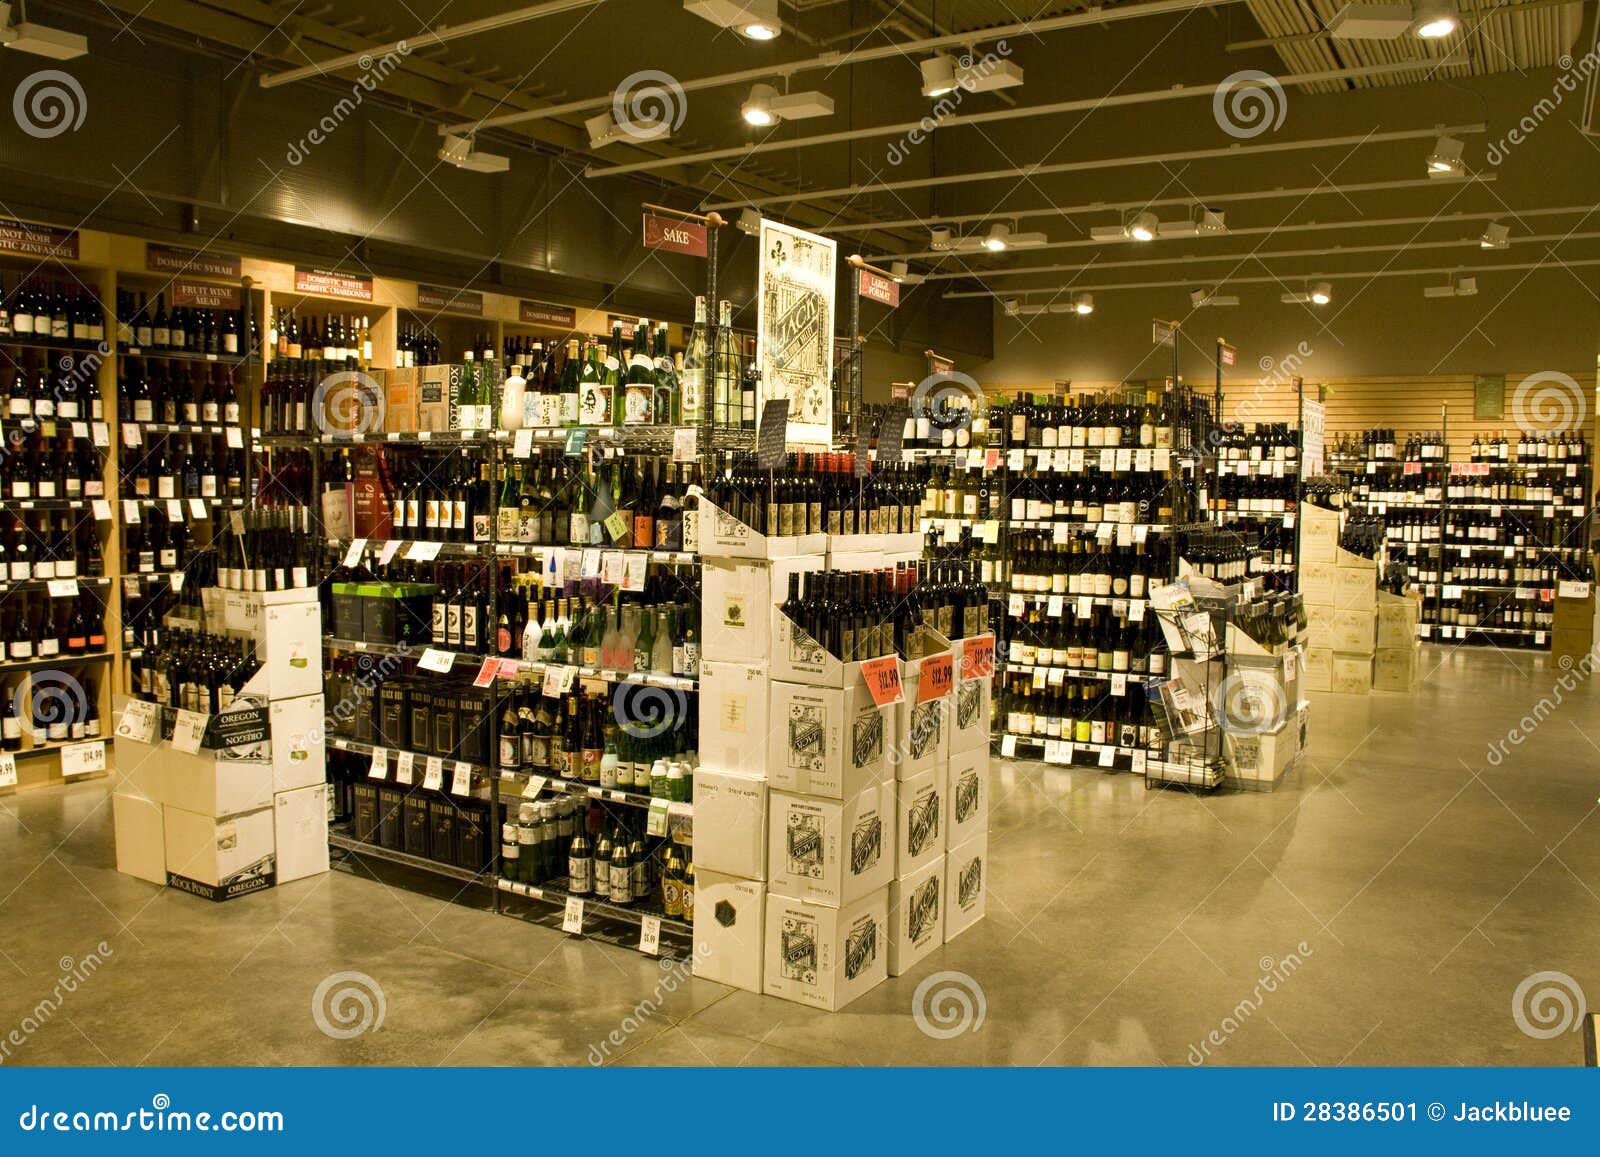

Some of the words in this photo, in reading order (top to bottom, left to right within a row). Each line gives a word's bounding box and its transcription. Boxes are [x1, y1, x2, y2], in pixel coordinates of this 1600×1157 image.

[25, 231, 50, 243] NOIR
[664, 228, 689, 245] SAKE
[21, 242, 74, 258] ZINFANDEL
[157, 257, 201, 271] DOMESTIC
[204, 264, 233, 275] SYRAH
[307, 275, 341, 286] DOMESTIC
[342, 279, 363, 289] WHITE
[871, 277, 889, 290] LARGE
[182, 285, 208, 295] FRUIT
[209, 287, 233, 297] WINE
[330, 287, 372, 299] CHARDONNAY
[869, 287, 891, 301] FORMAT
[195, 296, 220, 306] MEAD
[780, 291, 818, 347] JACK
[878, 669, 899, 690] $12.99
[931, 665, 952, 687] $12.99
[220, 711, 259, 725] OREGON
[226, 732, 263, 746] OREGON
[167, 874, 192, 892] ROCK
[192, 882, 215, 898] POINT
[228, 877, 266, 894] OREGON
